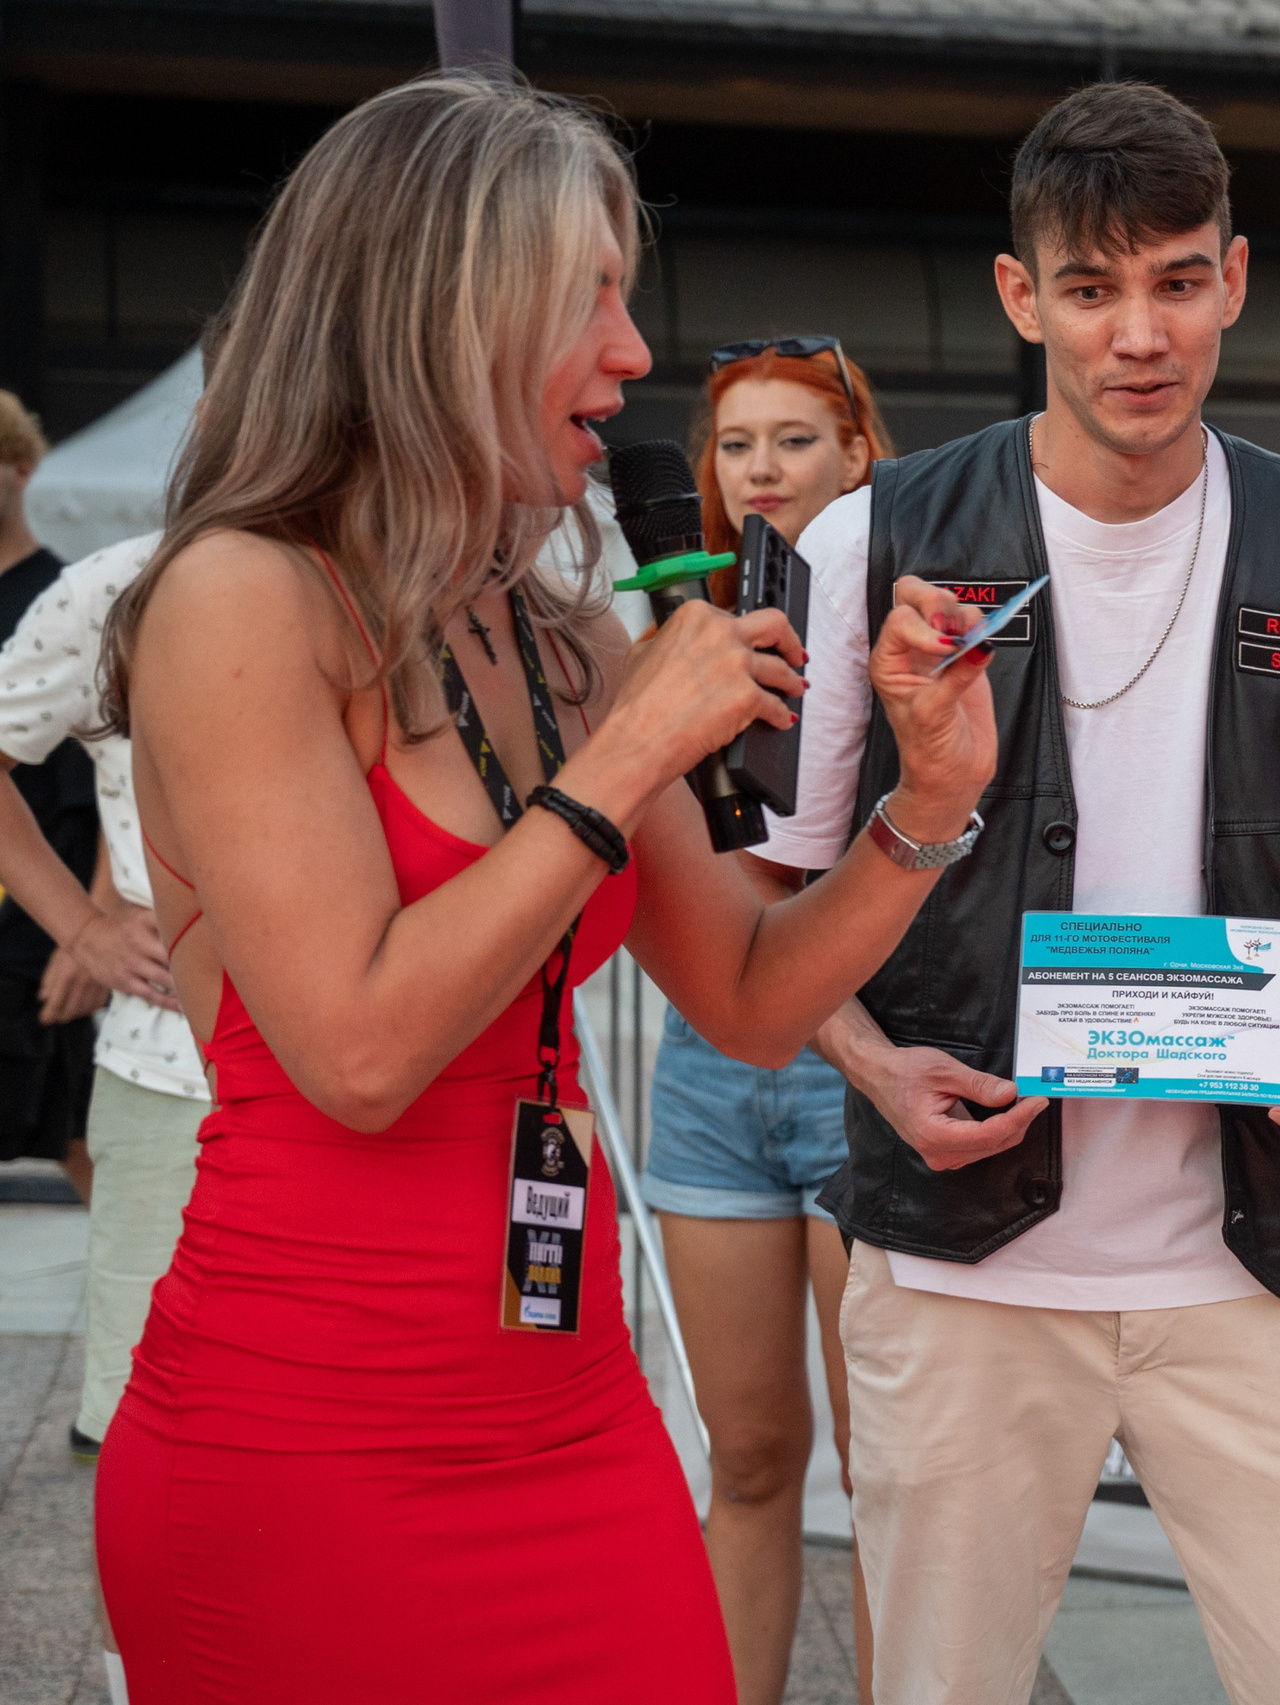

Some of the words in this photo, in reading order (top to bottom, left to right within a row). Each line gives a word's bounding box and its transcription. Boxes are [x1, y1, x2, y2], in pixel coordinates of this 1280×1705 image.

[944, 586, 996, 602] ZAKI
[1061, 922, 1142, 932] СПЕЦИАЛЬНО
[1030, 934, 1051, 943] ДЛЯ
[1082, 935, 1170, 944] МОТОФЕСТИВАЛЯ
[1046, 946, 1106, 954] "МЕДВЕЖЬЯ
[1109, 947, 1155, 955] ПОЛЯНА"
[1028, 971, 1090, 980] АБОНЕМЕНТ
[1092, 972, 1106, 980] НА
[1116, 973, 1164, 982] СЕАНСОВ
[1166, 974, 1244, 985] ЭКЗОМАССАЖА
[1112, 990, 1159, 999] ПРИХОДИ
[1161, 991, 1169, 999] И
[1171, 991, 1214, 1001] КАЙФУЙ!
[1188, 1005, 1230, 1013] ЭКЗОМАССАЖ
[1223, 1020, 1247, 1028] ЛЮБОЙ
[1087, 1047, 1149, 1061] Доктора
[1156, 1048, 1227, 1061] Шадского
[526, 1185, 571, 1221] Ведущий
